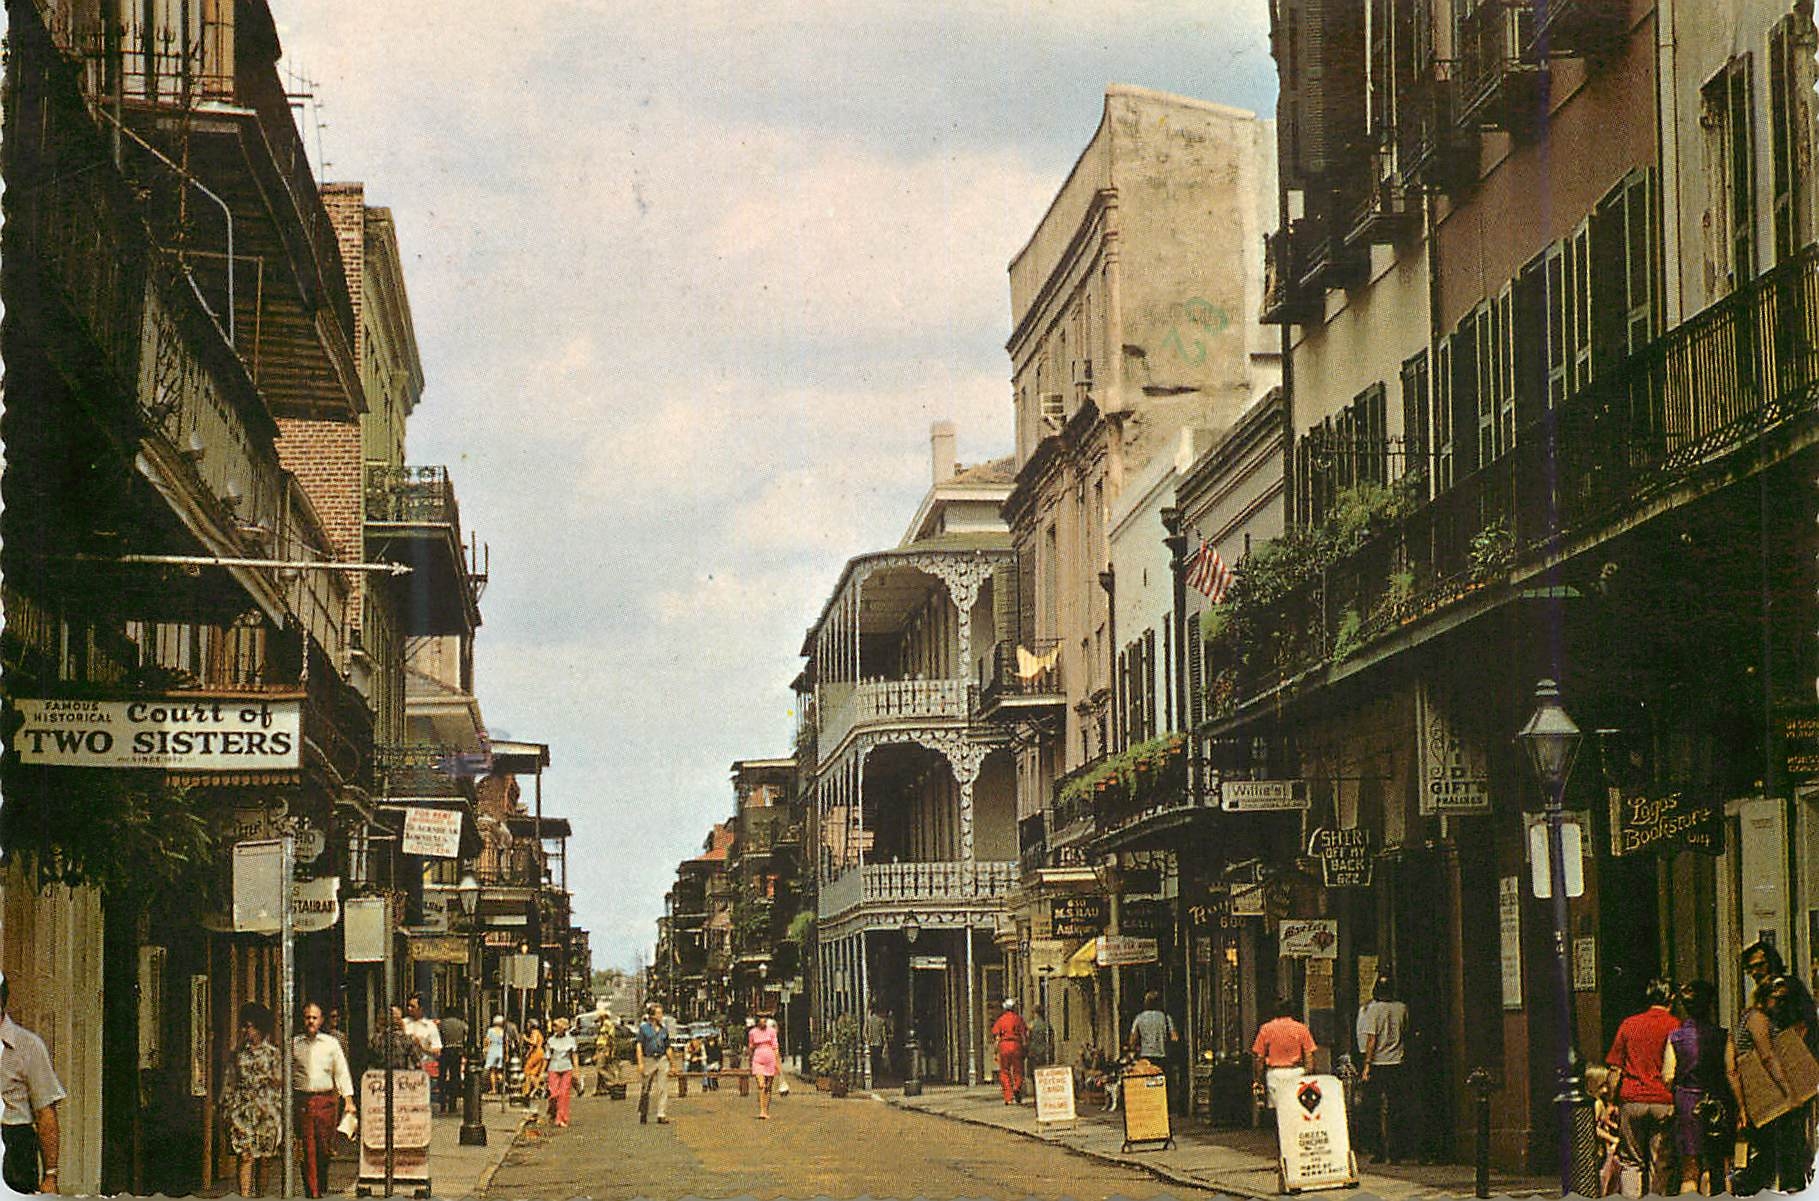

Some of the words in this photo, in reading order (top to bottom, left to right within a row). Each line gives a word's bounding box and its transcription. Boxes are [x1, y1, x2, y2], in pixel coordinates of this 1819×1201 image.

[45, 701, 99, 711] FAMOUS
[34, 712, 112, 723] HISTORICAL
[127, 703, 224, 723] Court
[239, 702, 273, 729] of
[24, 730, 114, 755] TWO
[132, 730, 291, 756] SISTERS
[1430, 781, 1488, 795] GIFTS
[1623, 807, 1713, 850] Bookstore
[1321, 830, 1370, 848] SHIRT
[1350, 846, 1366, 857] MY
[1331, 859, 1365, 871] BACK
